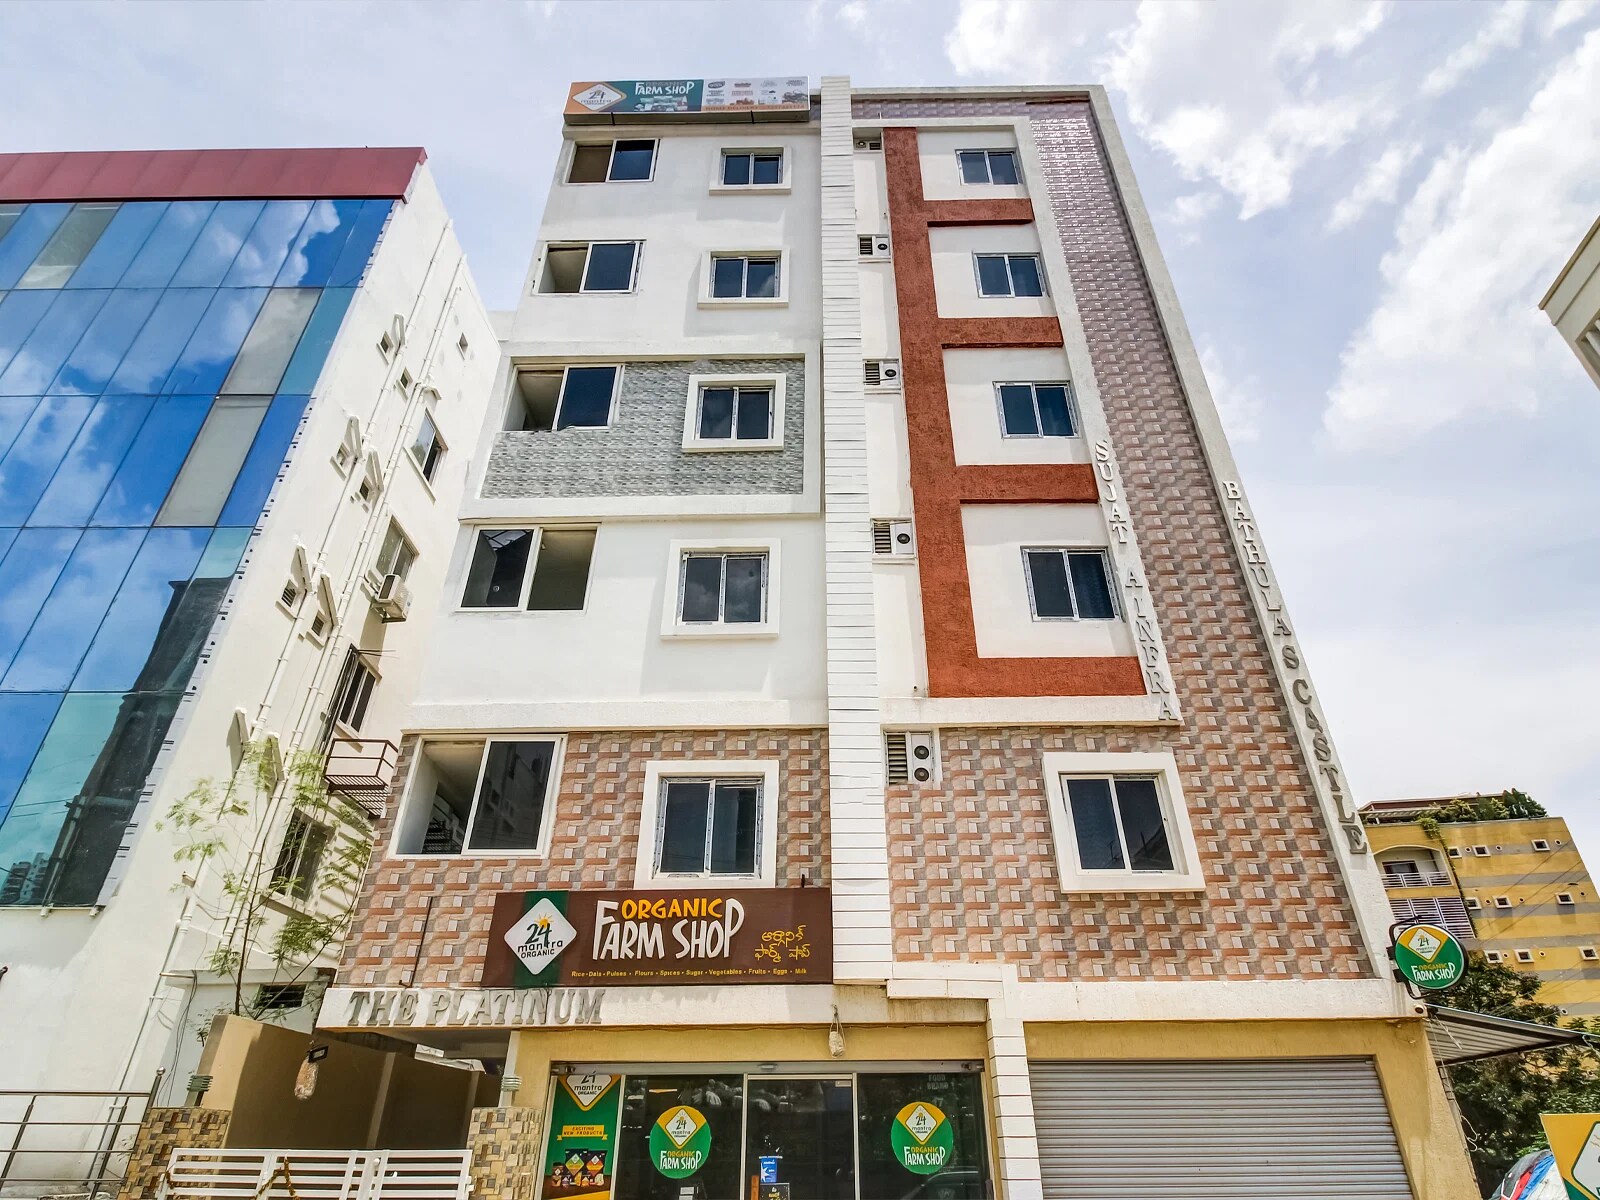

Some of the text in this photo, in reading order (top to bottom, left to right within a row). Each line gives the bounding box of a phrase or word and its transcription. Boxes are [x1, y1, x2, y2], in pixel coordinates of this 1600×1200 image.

[635, 82, 663, 95] FARM
[665, 81, 695, 95] SHOP
[1222, 480, 1368, 855] BATHULAS CASTLE
[621, 898, 723, 919] ORGANIC
[525, 922, 553, 948] 24
[592, 898, 745, 960] FARM SHOP
[1417, 937, 1430, 947] 24
[520, 949, 555, 959] ORGANIC
[660, 969, 680, 977] Spices
[685, 969, 704, 977] Sugar
[708, 968, 742, 976] Vegetables
[772, 968, 788, 976] Eggs
[1410, 962, 1456, 981] FARM SHOP
[1418, 962, 1447, 970] ORGANIC
[347, 989, 606, 1026] THE PLATINUM
[675, 1119, 688, 1131] 24
[915, 1115, 927, 1126] 24
[660, 1150, 702, 1170] FARM SHOP
[903, 1145, 946, 1166] FARM SHOP
